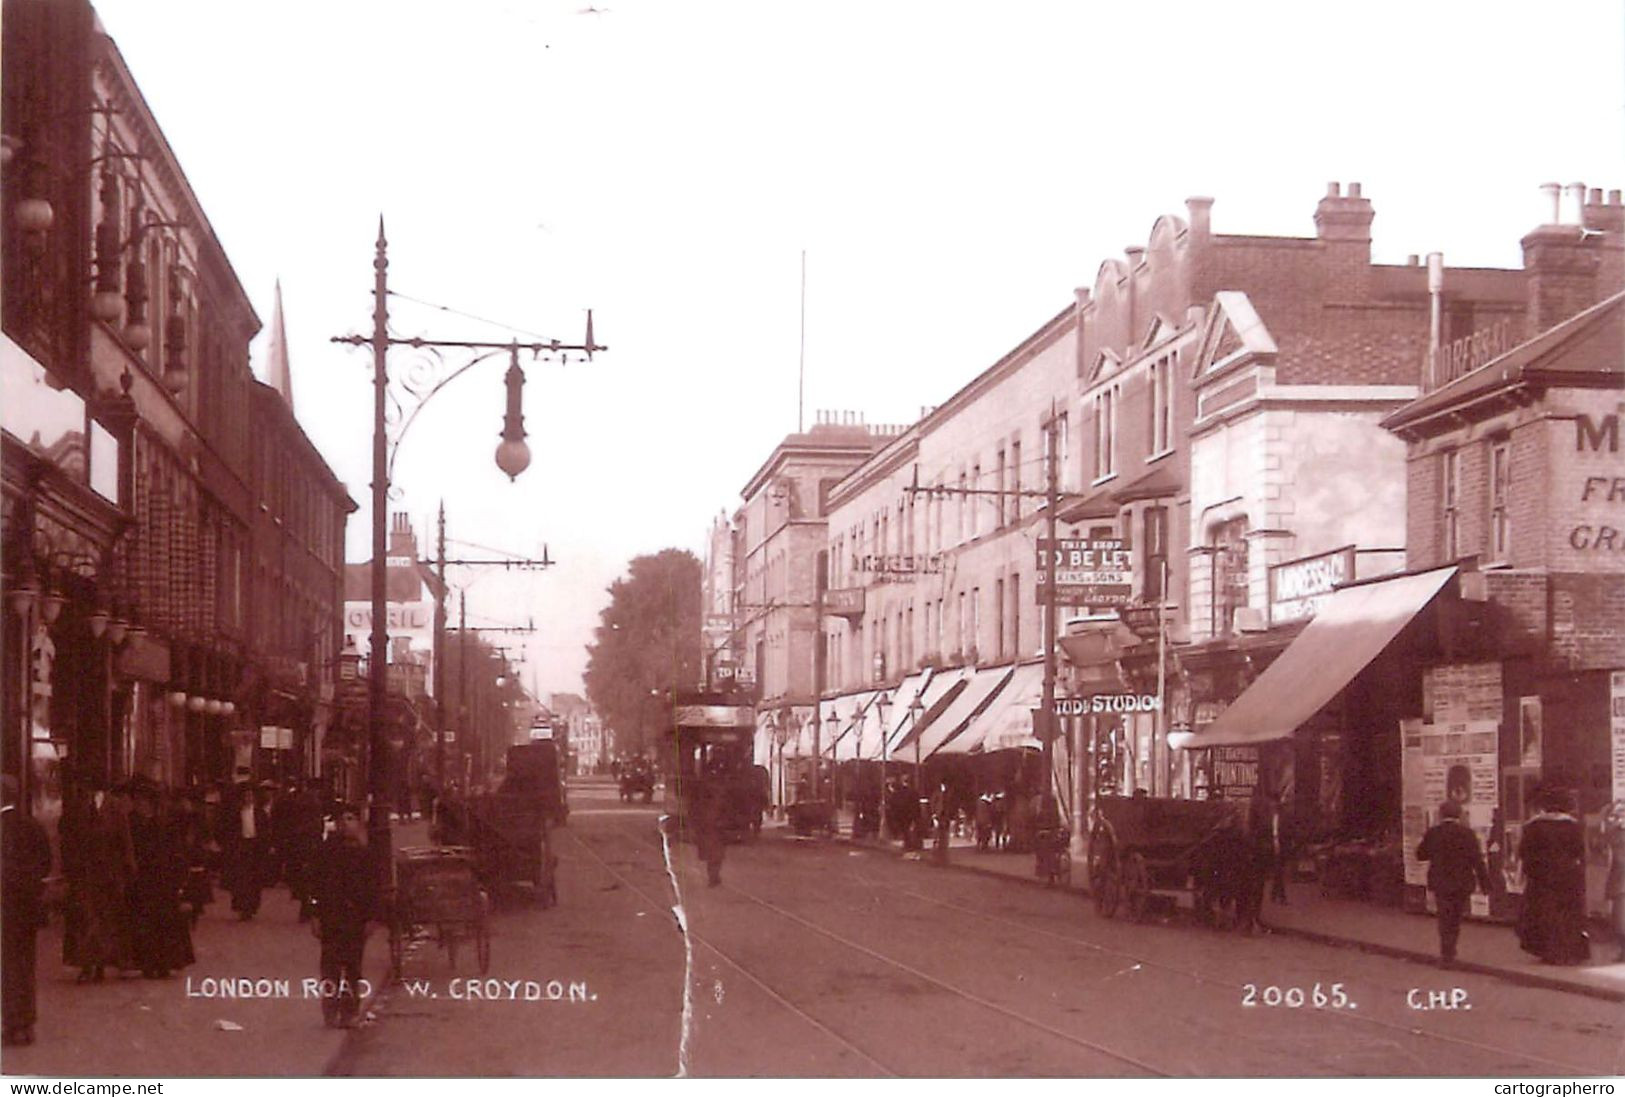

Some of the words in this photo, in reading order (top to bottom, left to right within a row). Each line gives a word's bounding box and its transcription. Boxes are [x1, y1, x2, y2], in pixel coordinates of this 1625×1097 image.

[1570, 525, 1625, 551] GR
[1070, 551, 1095, 567] BE
[1102, 551, 1132, 567] LET
[349, 609, 425, 629] ORIL
